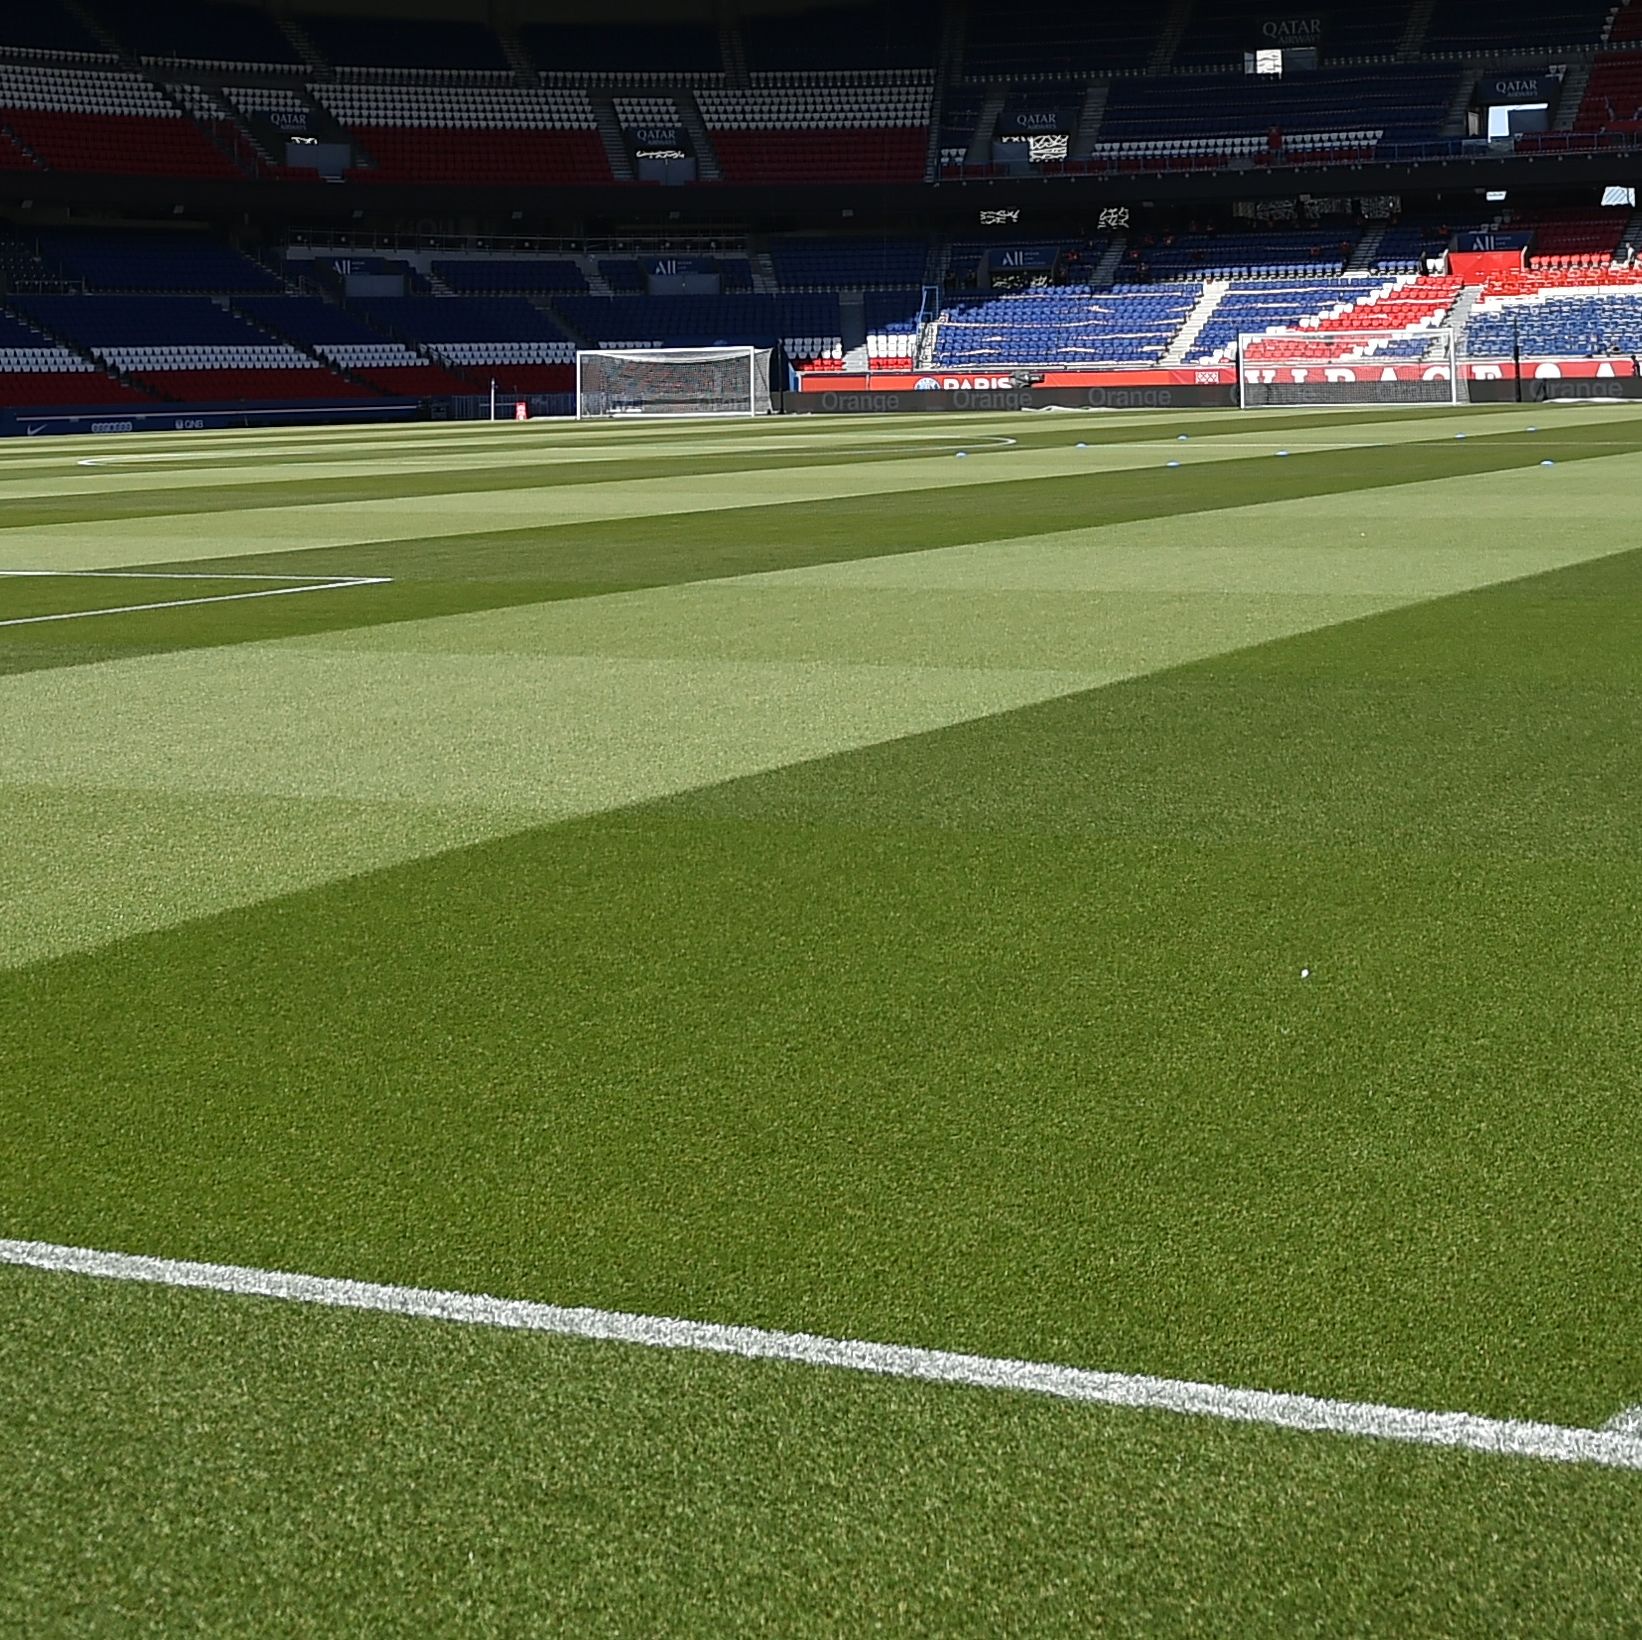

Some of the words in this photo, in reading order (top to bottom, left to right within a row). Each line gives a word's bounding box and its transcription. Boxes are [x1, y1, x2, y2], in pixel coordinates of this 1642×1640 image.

[1262, 19, 1321, 39] QATAR
[1495, 79, 1538, 95] QATAR
[270, 112, 306, 126] QATAR
[1016, 113, 1057, 127] QATAR
[636, 129, 676, 142] QATAR
[821, 392, 899, 412] Orange
[953, 390, 1032, 411] Orange
[1088, 386, 1171, 408] Orange
